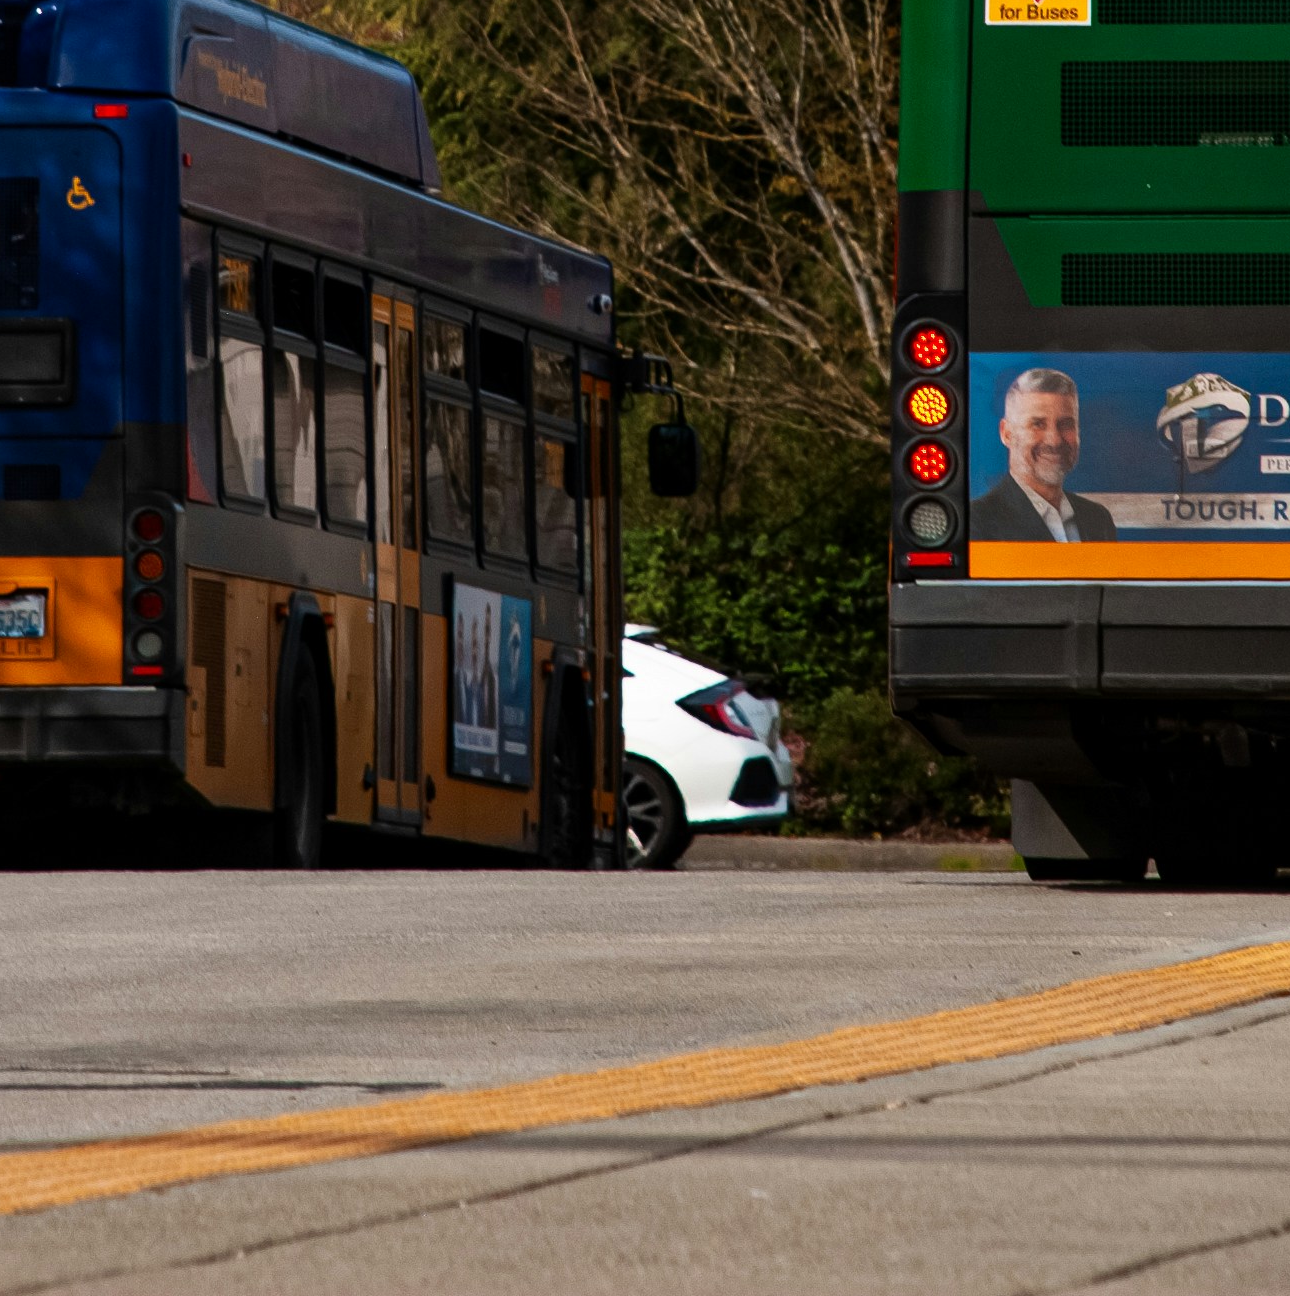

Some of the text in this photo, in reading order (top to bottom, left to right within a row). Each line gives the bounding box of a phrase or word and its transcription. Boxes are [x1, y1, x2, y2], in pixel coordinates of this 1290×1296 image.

[999, 3, 1080, 21] for Buses
[1161, 499, 1265, 521] TOUGH.
